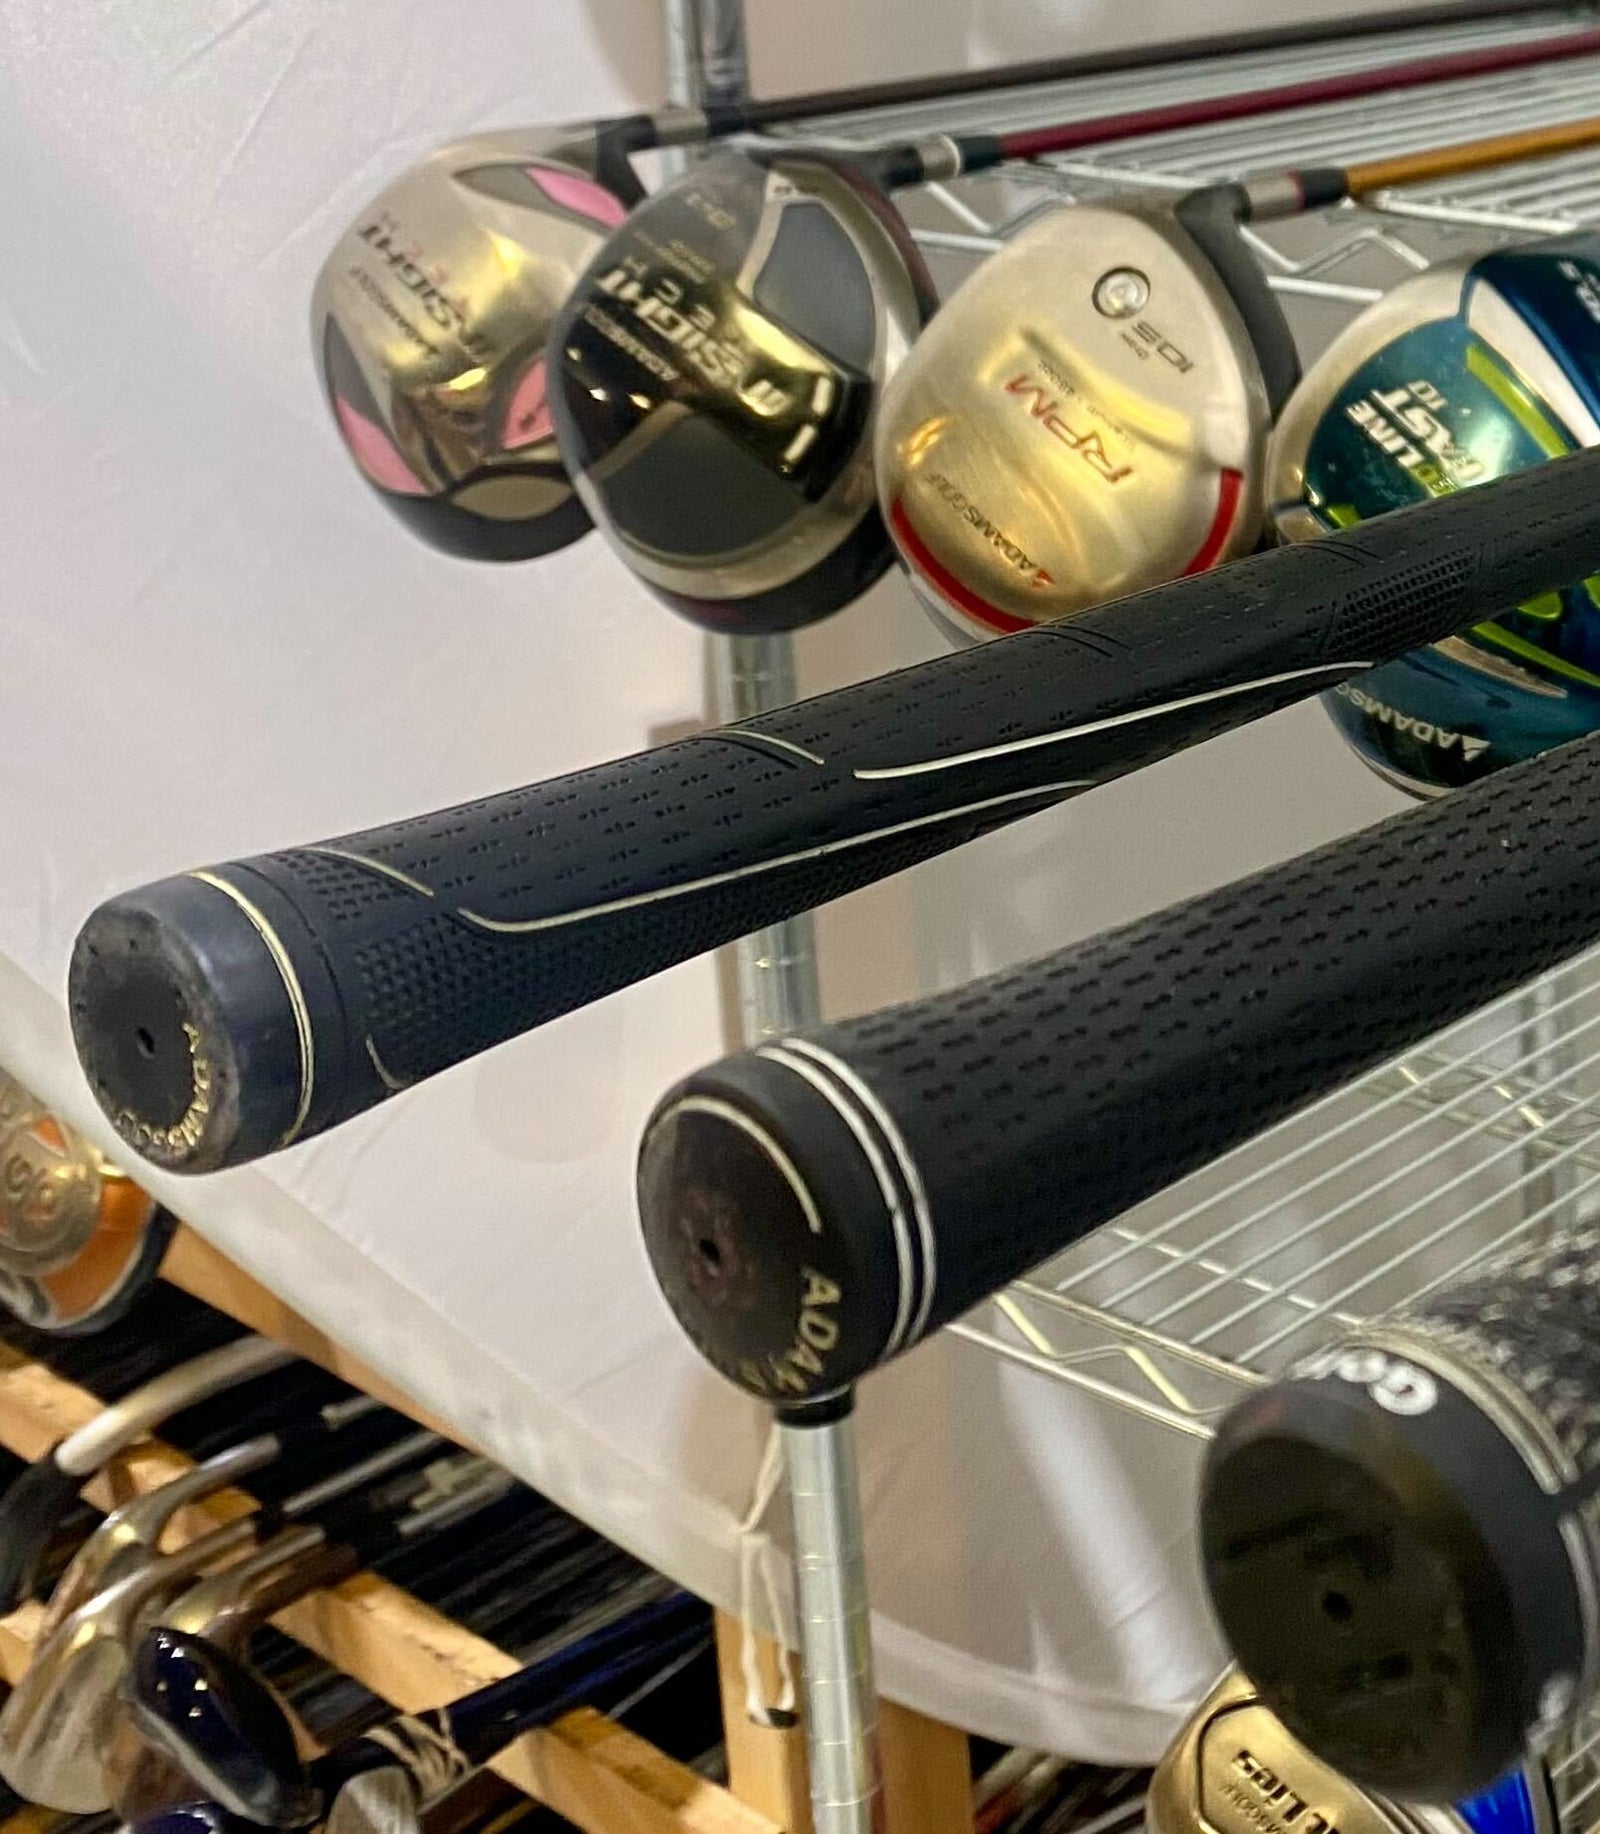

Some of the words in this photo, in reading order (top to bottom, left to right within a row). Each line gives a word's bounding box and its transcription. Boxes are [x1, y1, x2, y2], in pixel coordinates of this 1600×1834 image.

[1001, 372, 1135, 484] RPM
[923, 471, 1037, 570] ADAMSGOLF
[1231, 1748, 1308, 1823] Lies
